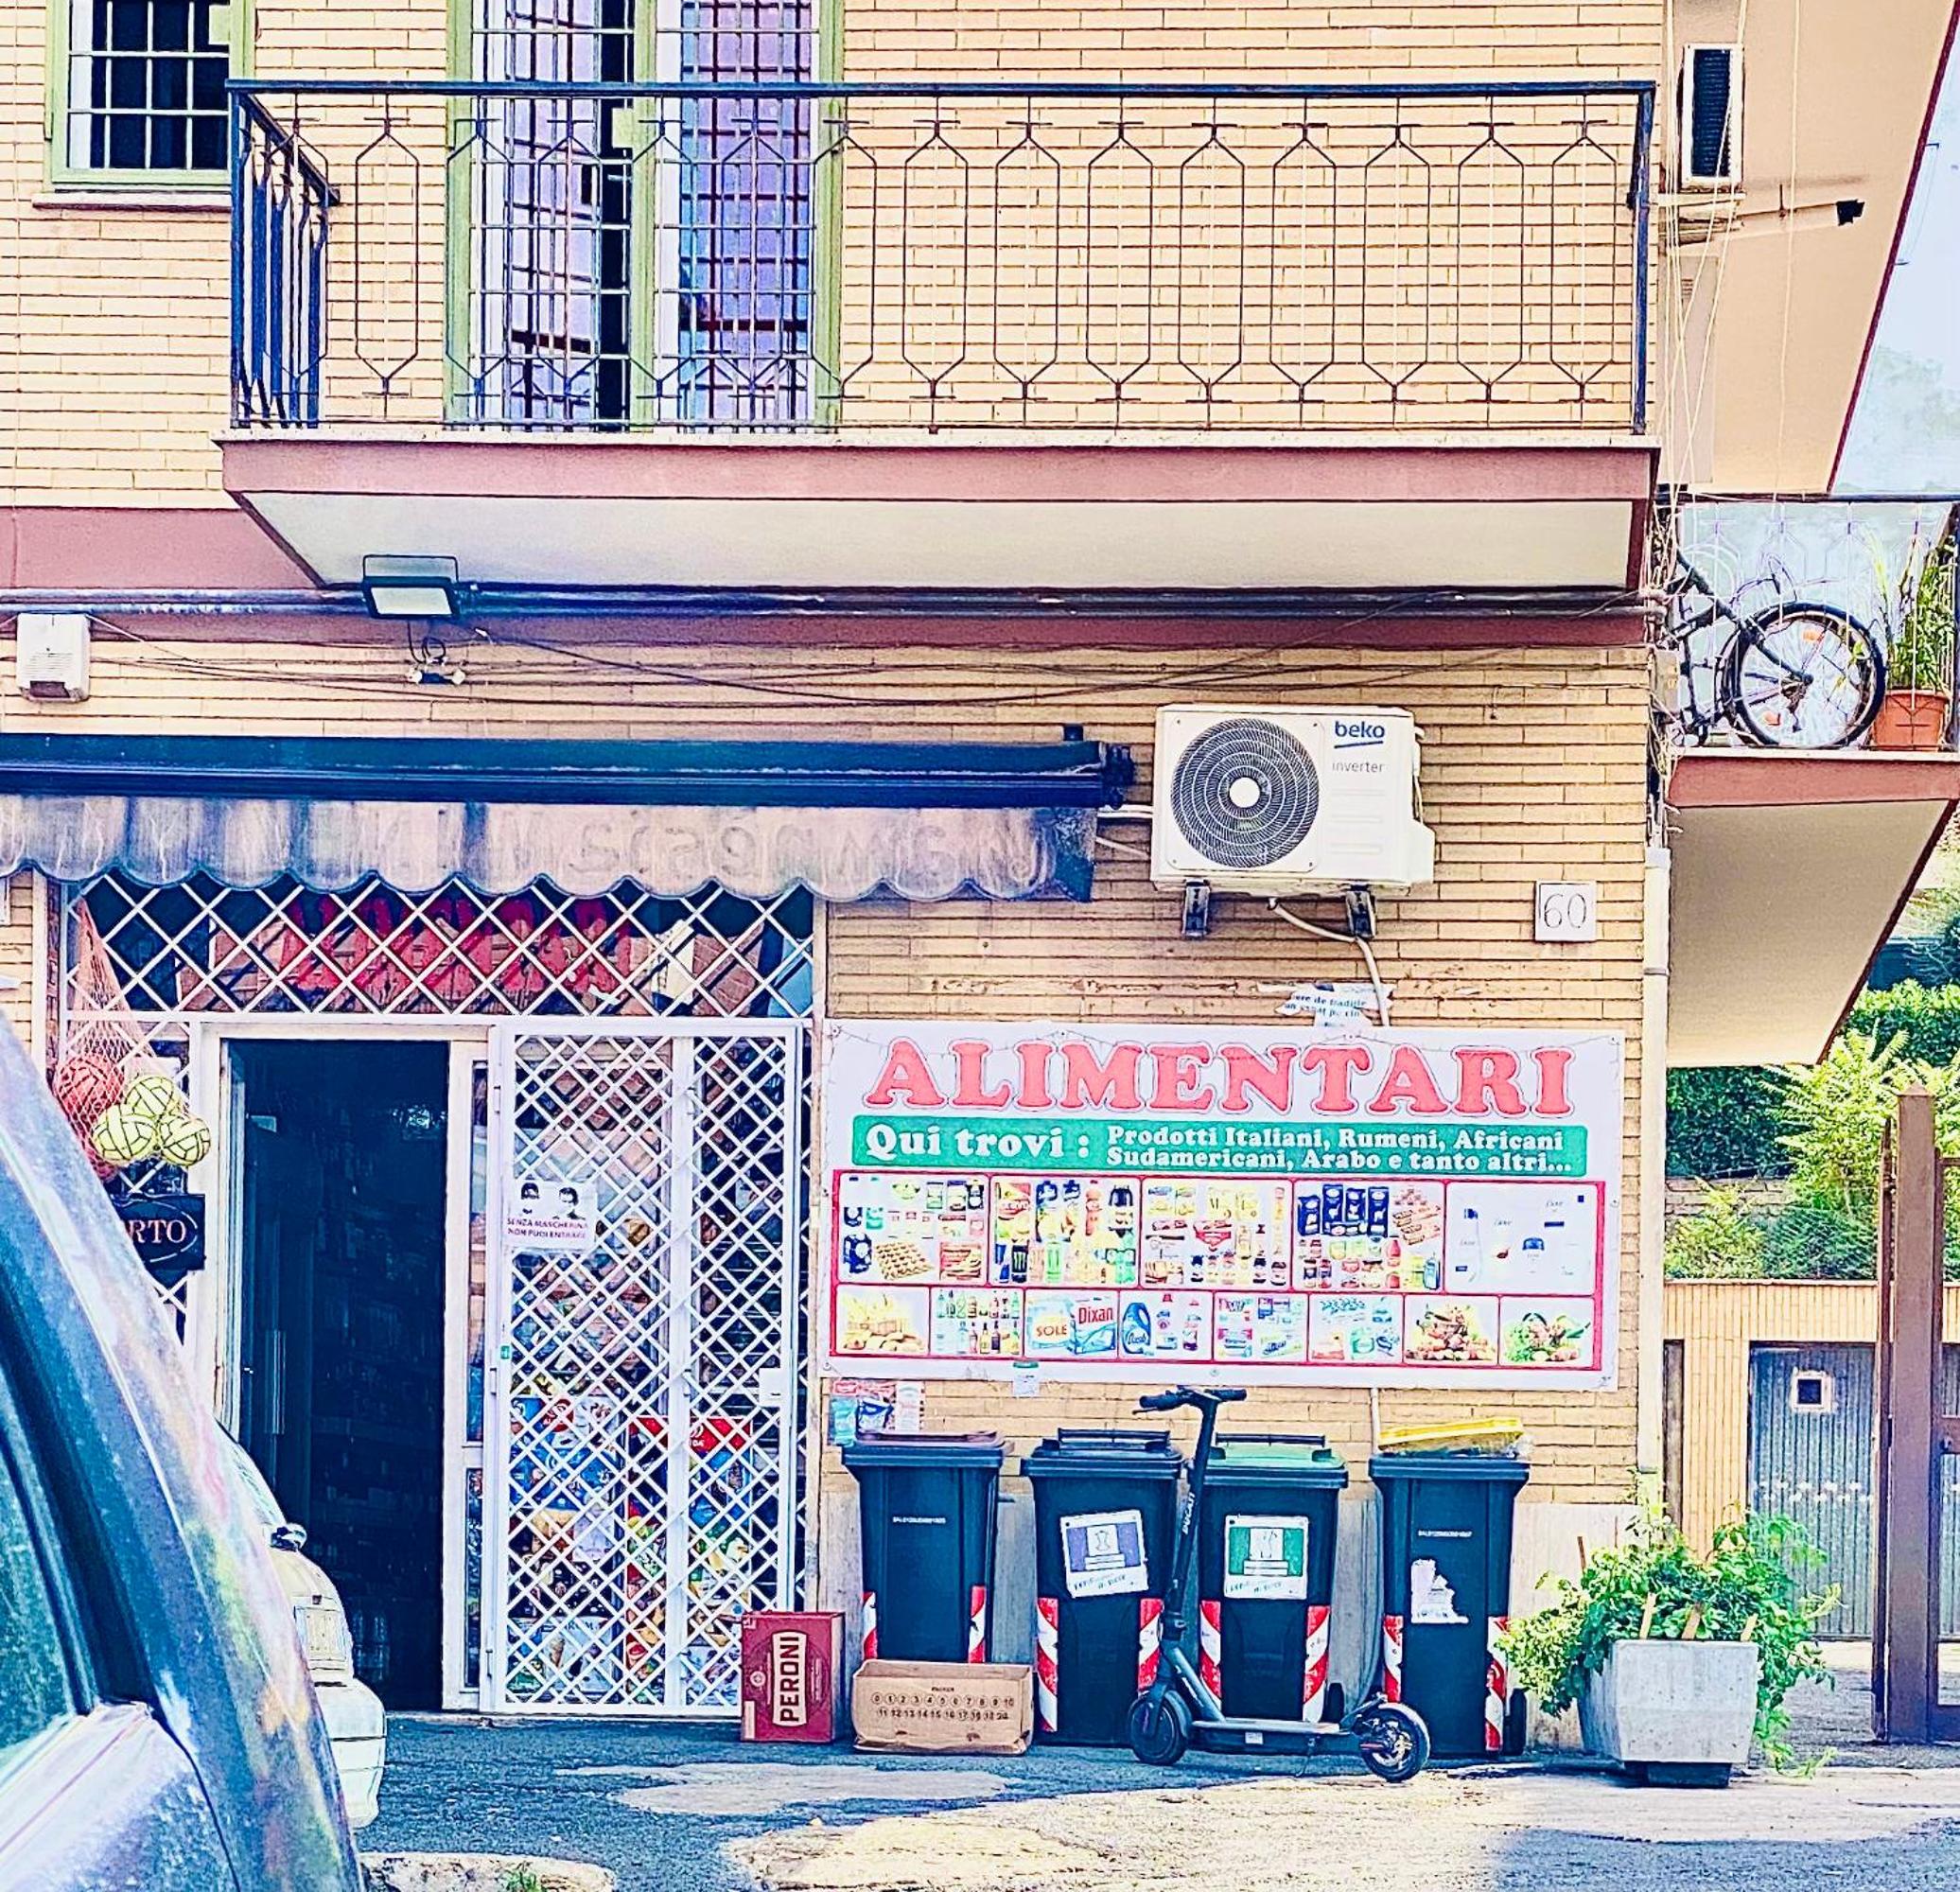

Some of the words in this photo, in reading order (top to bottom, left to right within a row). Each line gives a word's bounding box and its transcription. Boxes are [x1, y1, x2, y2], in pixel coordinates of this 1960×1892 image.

[1335, 720, 1386, 739] beko
[1332, 760, 1386, 774] inverter
[1543, 893, 1587, 929] 60
[864, 1036, 1575, 1118] ALIMENTARI
[866, 1123, 940, 1161] Qui
[1106, 1125, 1218, 1146] Prodotti
[1224, 1126, 1331, 1152] Italiani,
[1339, 1128, 1446, 1153] Rumeni,
[1453, 1130, 1565, 1152] Africani
[1106, 1146, 1295, 1172] Sudamericani,
[1302, 1148, 1381, 1169] Arabo
[1388, 1154, 1402, 1169] e
[1409, 1151, 1480, 1172] tanto
[1487, 1150, 1572, 1173] altri...
[1036, 1324, 1068, 1337] SOLE
[1078, 1305, 1113, 1324] Dixan
[779, 1636, 799, 1723] PERONI
